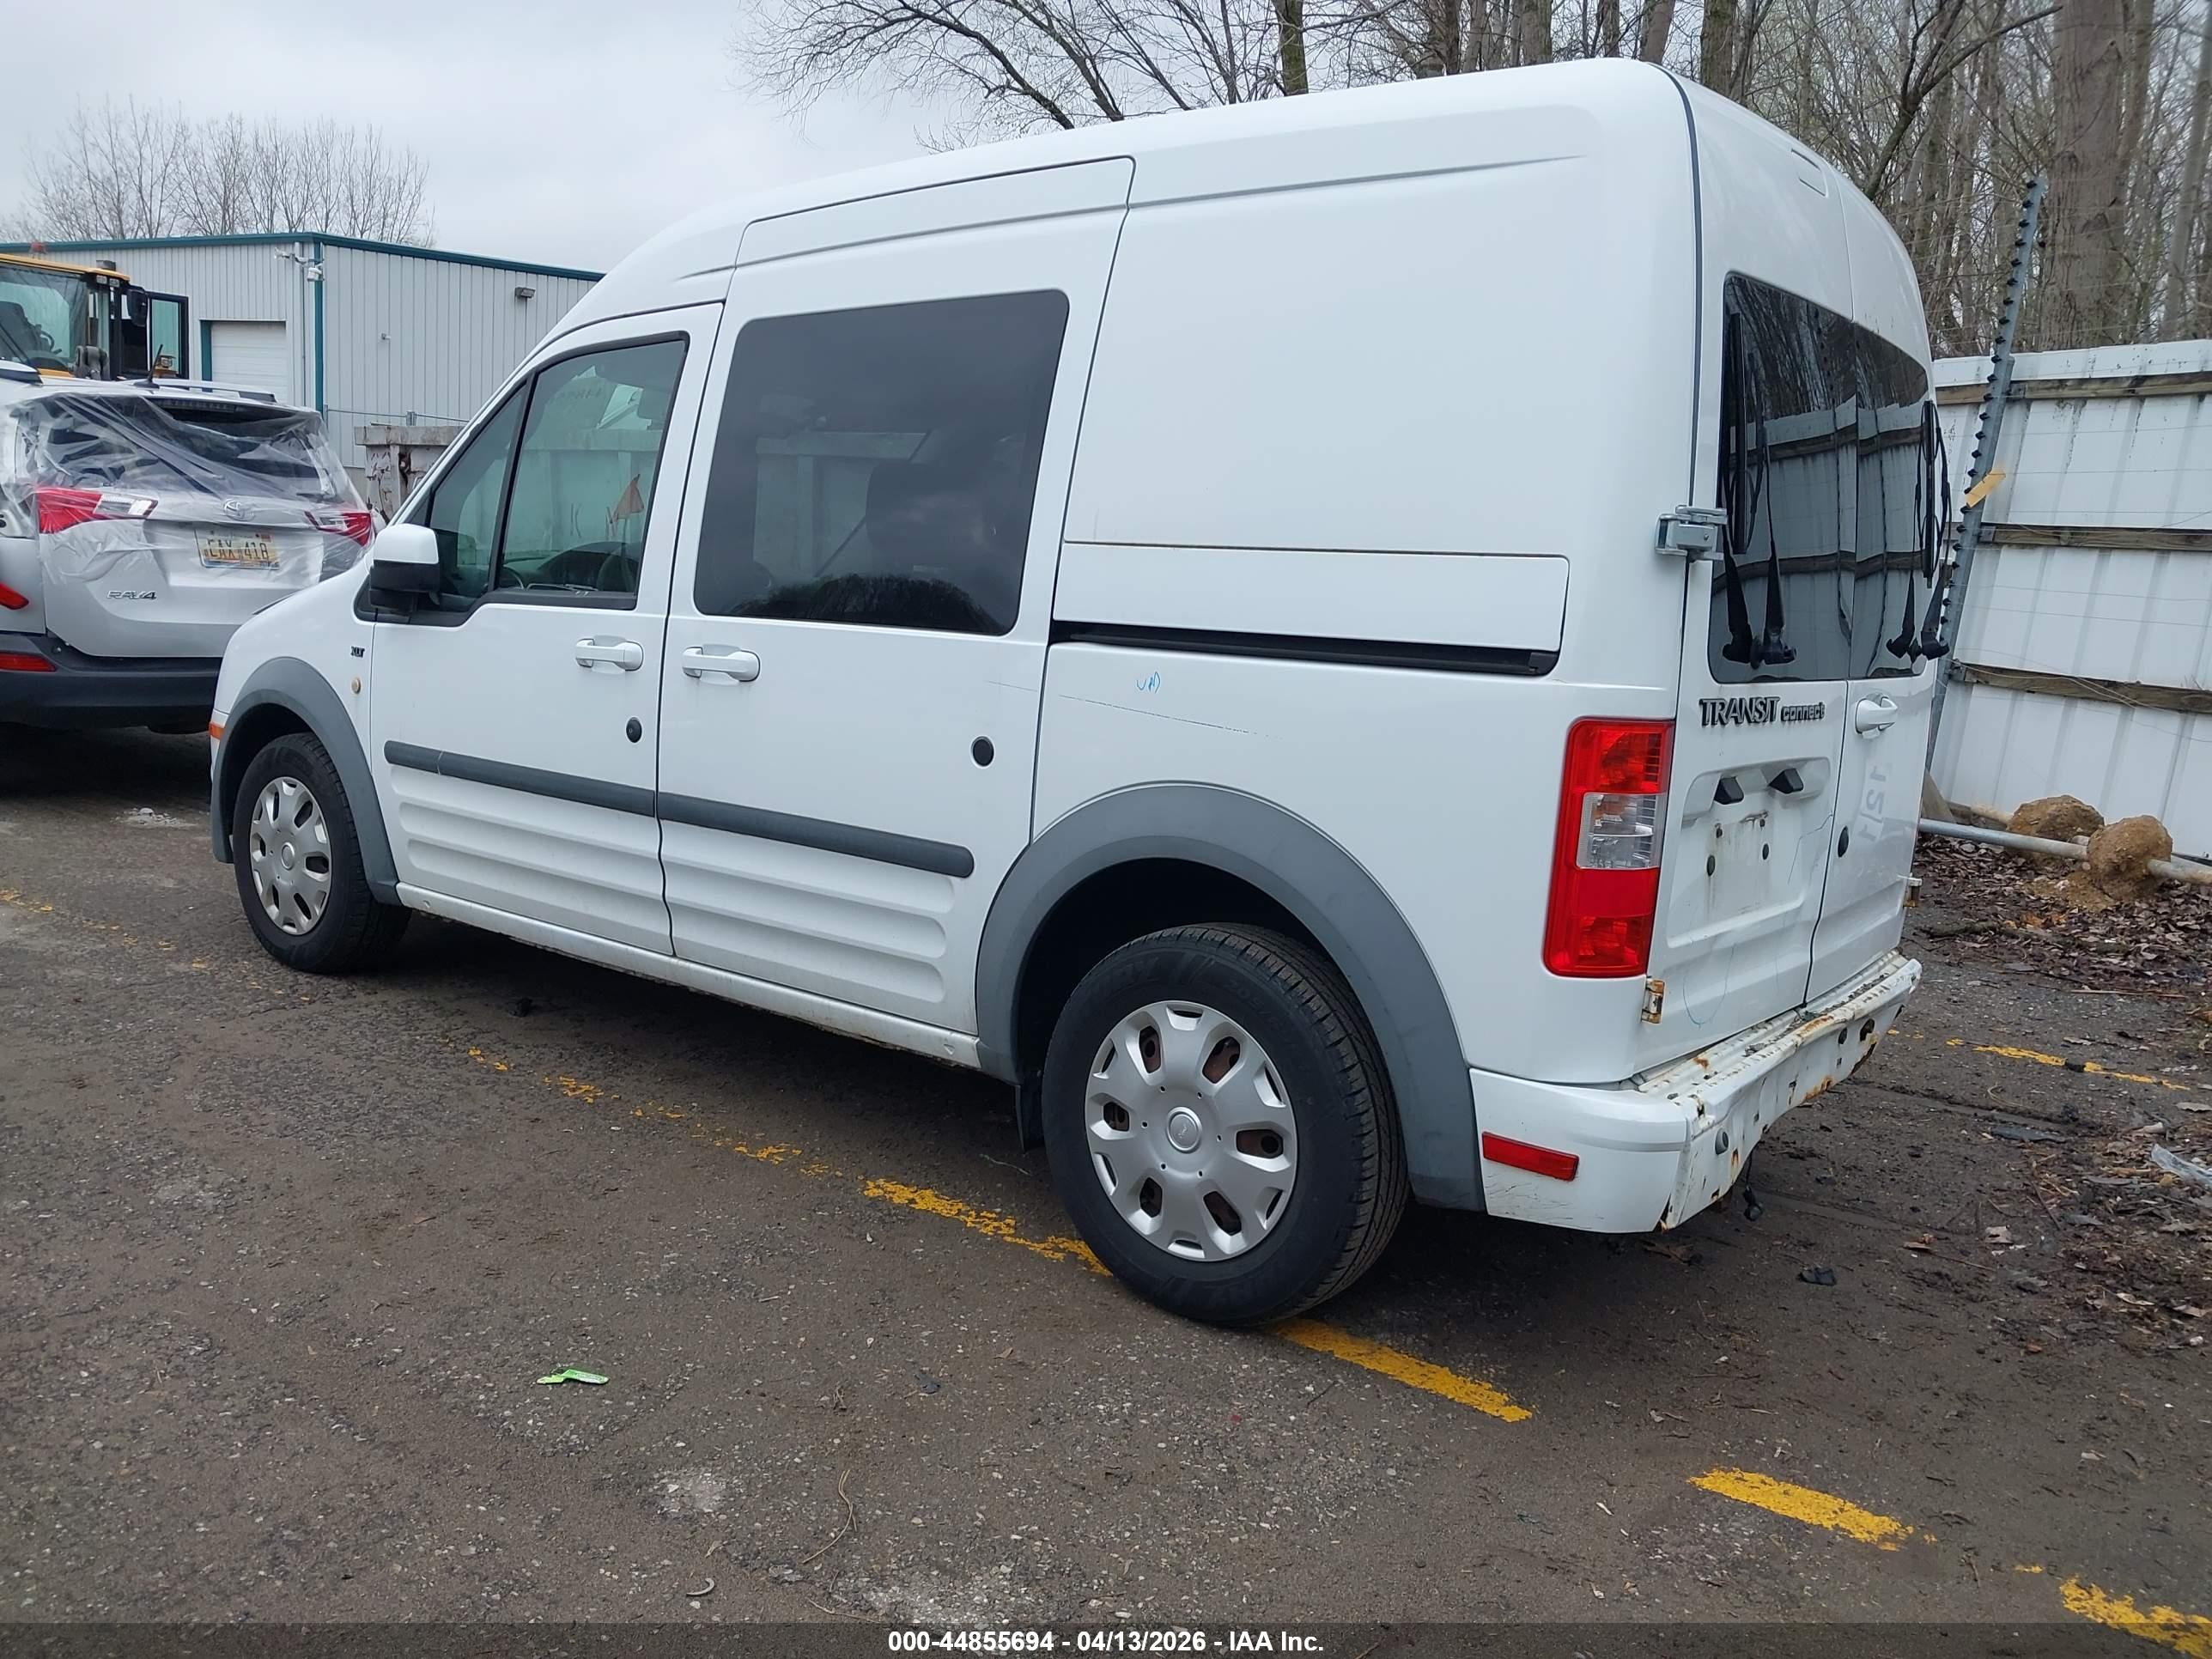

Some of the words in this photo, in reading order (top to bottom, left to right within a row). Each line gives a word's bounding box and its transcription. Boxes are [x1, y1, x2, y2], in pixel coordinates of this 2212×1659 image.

[106, 590, 157, 599] RAV4
[1699, 696, 1780, 726] TRANSIT
[1780, 700, 1826, 722] connect
